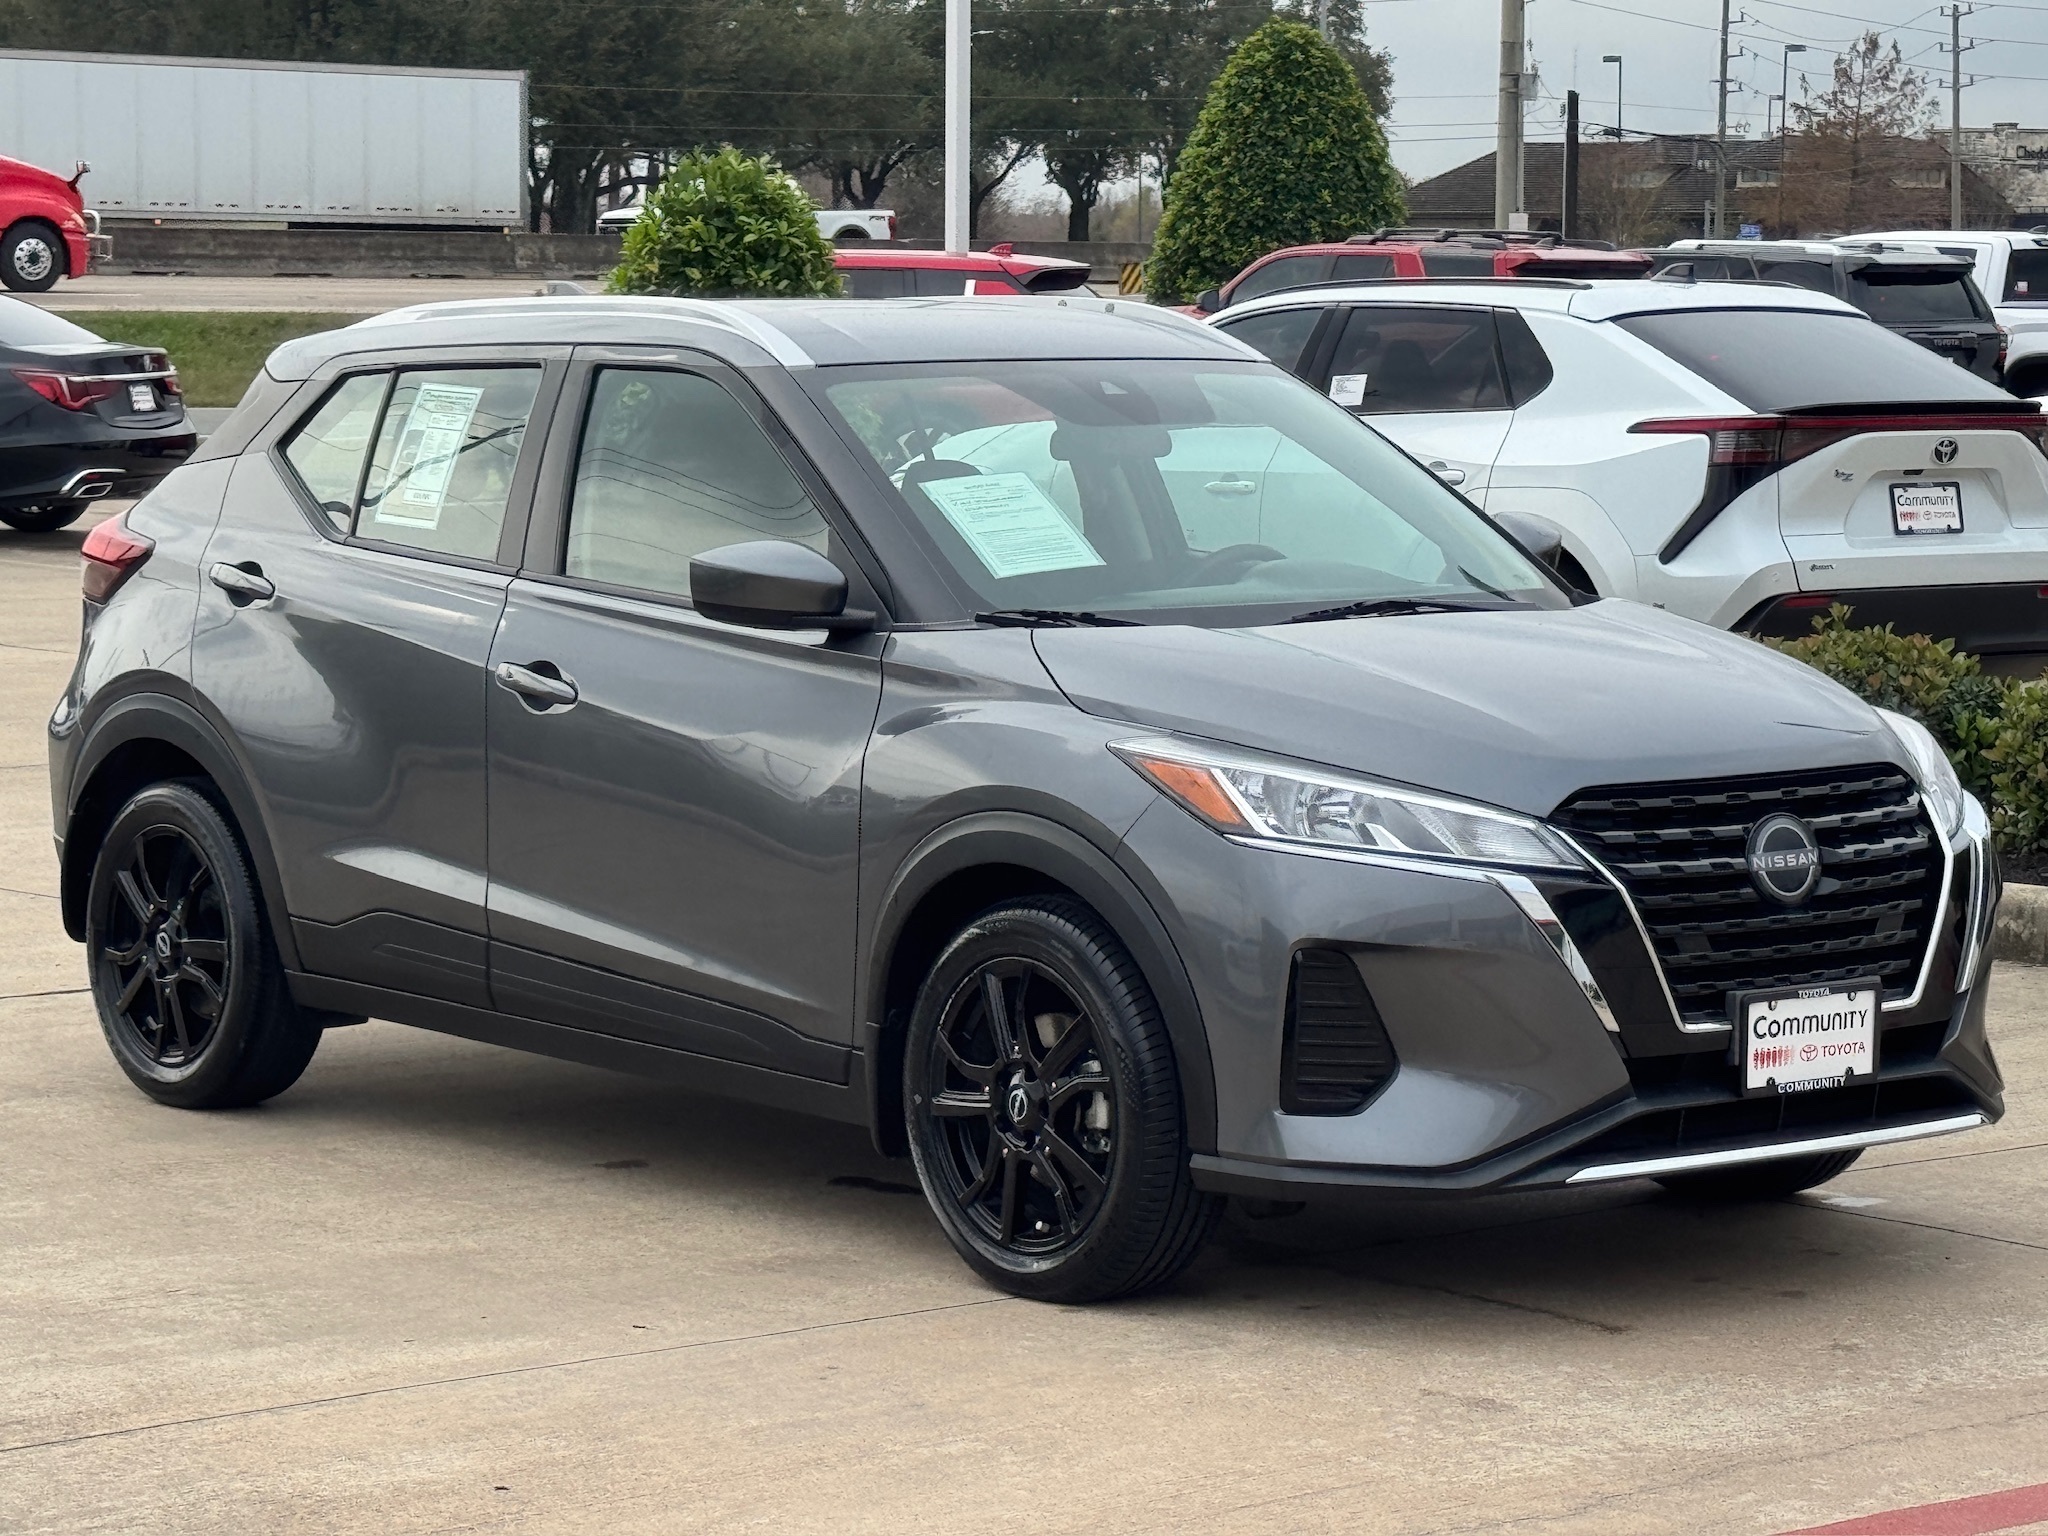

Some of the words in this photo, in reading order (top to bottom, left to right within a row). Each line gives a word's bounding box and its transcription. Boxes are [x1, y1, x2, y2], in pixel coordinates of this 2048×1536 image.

[1933, 511, 1956, 519] TOYOTA
[1752, 851, 1818, 869] NISSAN
[1798, 987, 1831, 999] TOYOTA
[1821, 1041, 1866, 1058] TOYOTA
[1777, 1075, 1847, 1094] COMMUNITY
